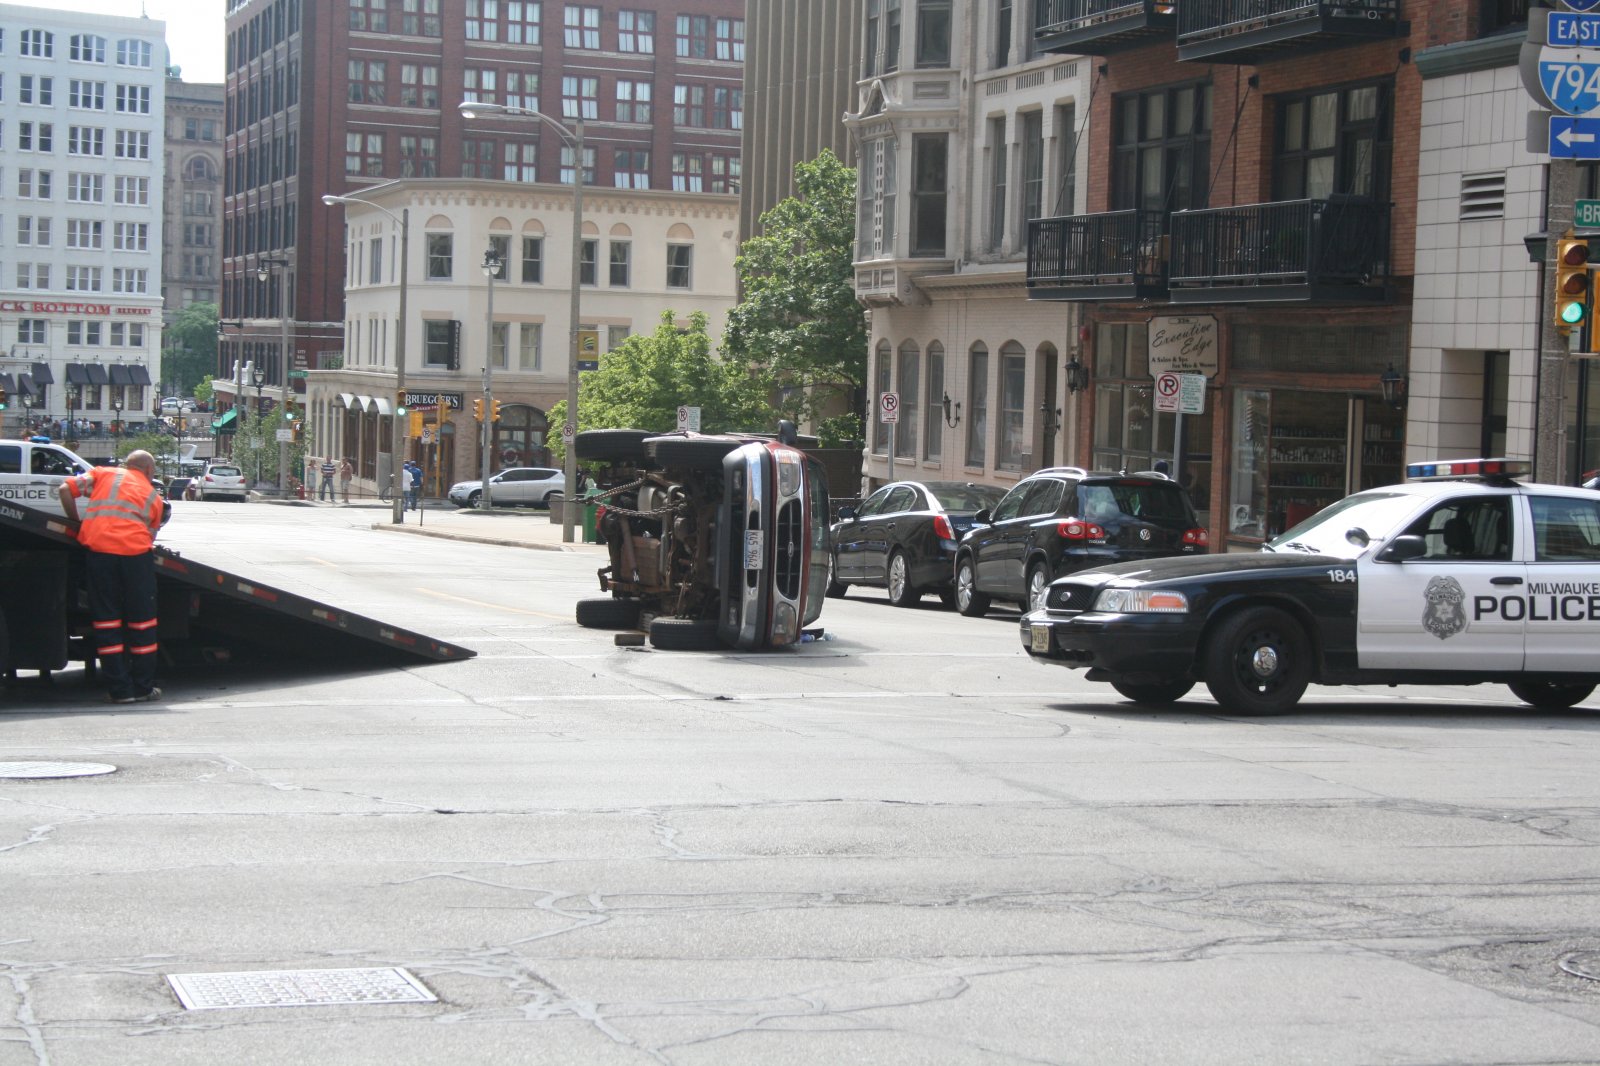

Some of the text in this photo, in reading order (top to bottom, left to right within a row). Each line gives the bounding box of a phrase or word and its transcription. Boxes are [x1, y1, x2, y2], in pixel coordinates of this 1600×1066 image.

[1558, 20, 1600, 40] EAST
[1548, 64, 1600, 102] 794
[1577, 209, 1583, 218] N
[32, 302, 110, 315] BOTTOM
[1152, 322, 1212, 348] Executive
[1180, 335, 1213, 357] Edge
[1327, 569, 1357, 582] 184
[1474, 595, 1600, 621] POLICE
